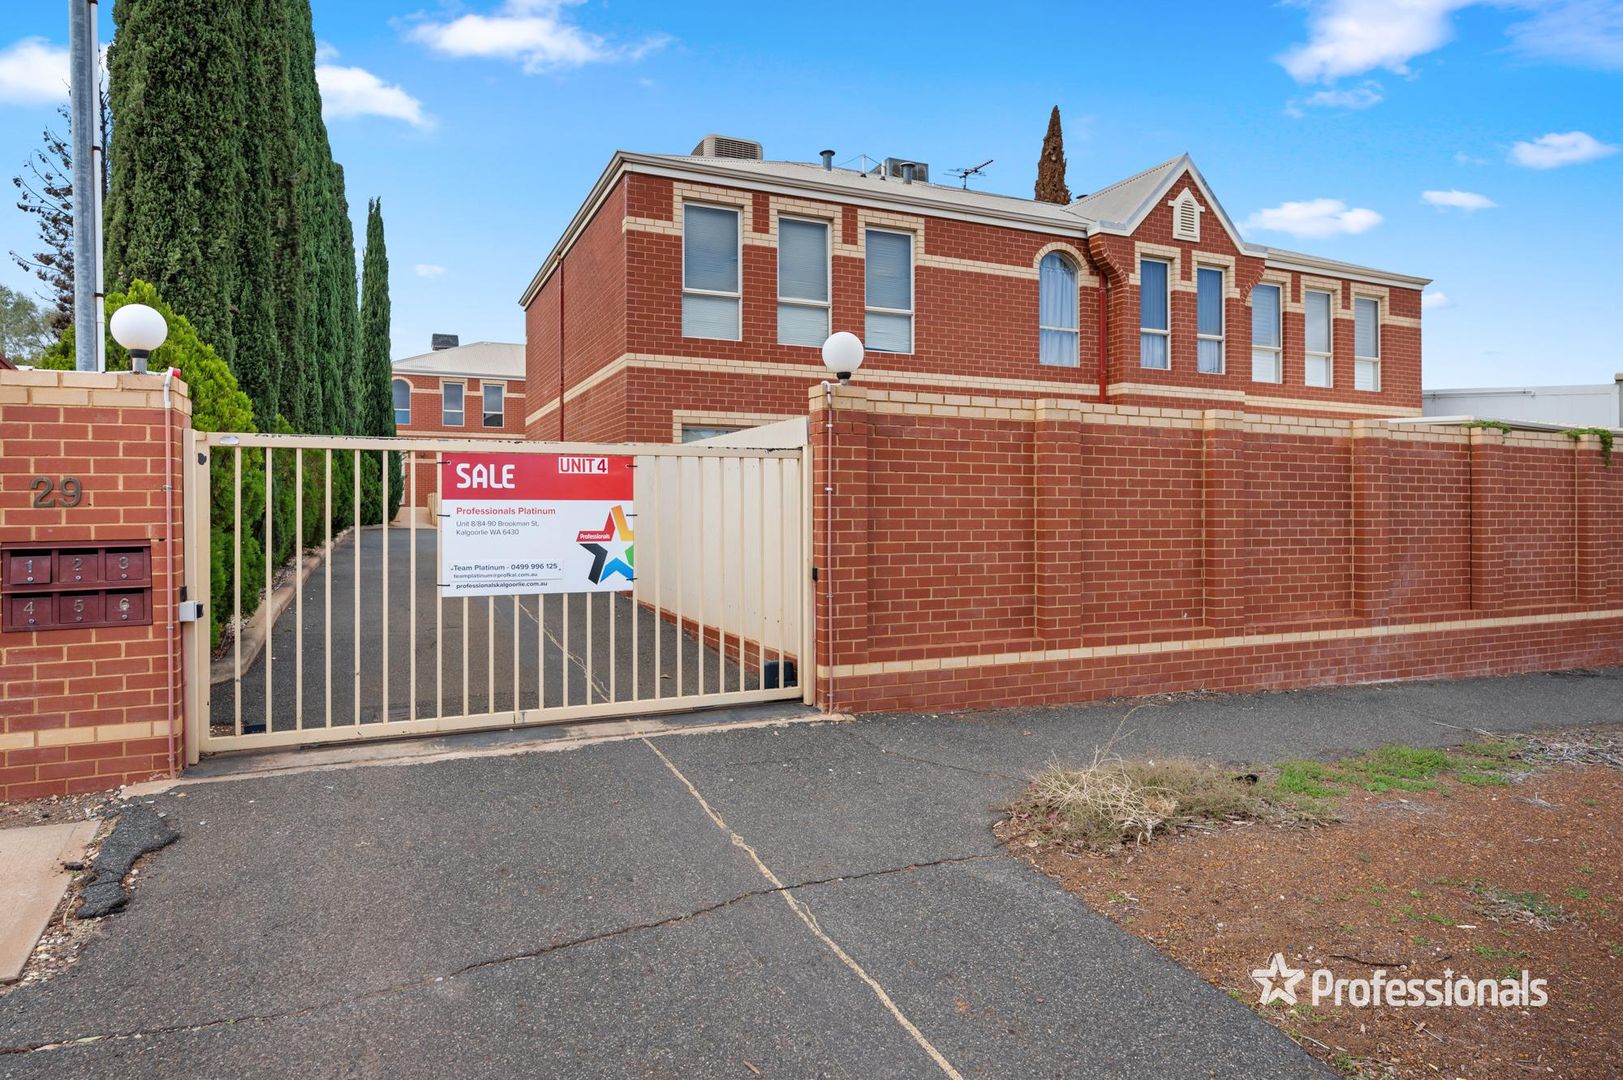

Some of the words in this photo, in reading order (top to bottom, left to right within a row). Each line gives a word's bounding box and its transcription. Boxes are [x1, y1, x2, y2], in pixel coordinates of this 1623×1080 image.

[456, 463, 516, 489] SALE
[31, 477, 82, 508] 29
[456, 507, 516, 515] Professionals
[518, 507, 556, 515] Platinum
[456, 529, 489, 537] Kalgoorlie
[24, 560, 34, 573] 1
[73, 558, 82, 571] 2
[119, 556, 129, 570] 3
[456, 582, 548, 590] professionalskalgoorlie.com.au
[24, 601, 34, 614] 4
[74, 599, 85, 613] 5
